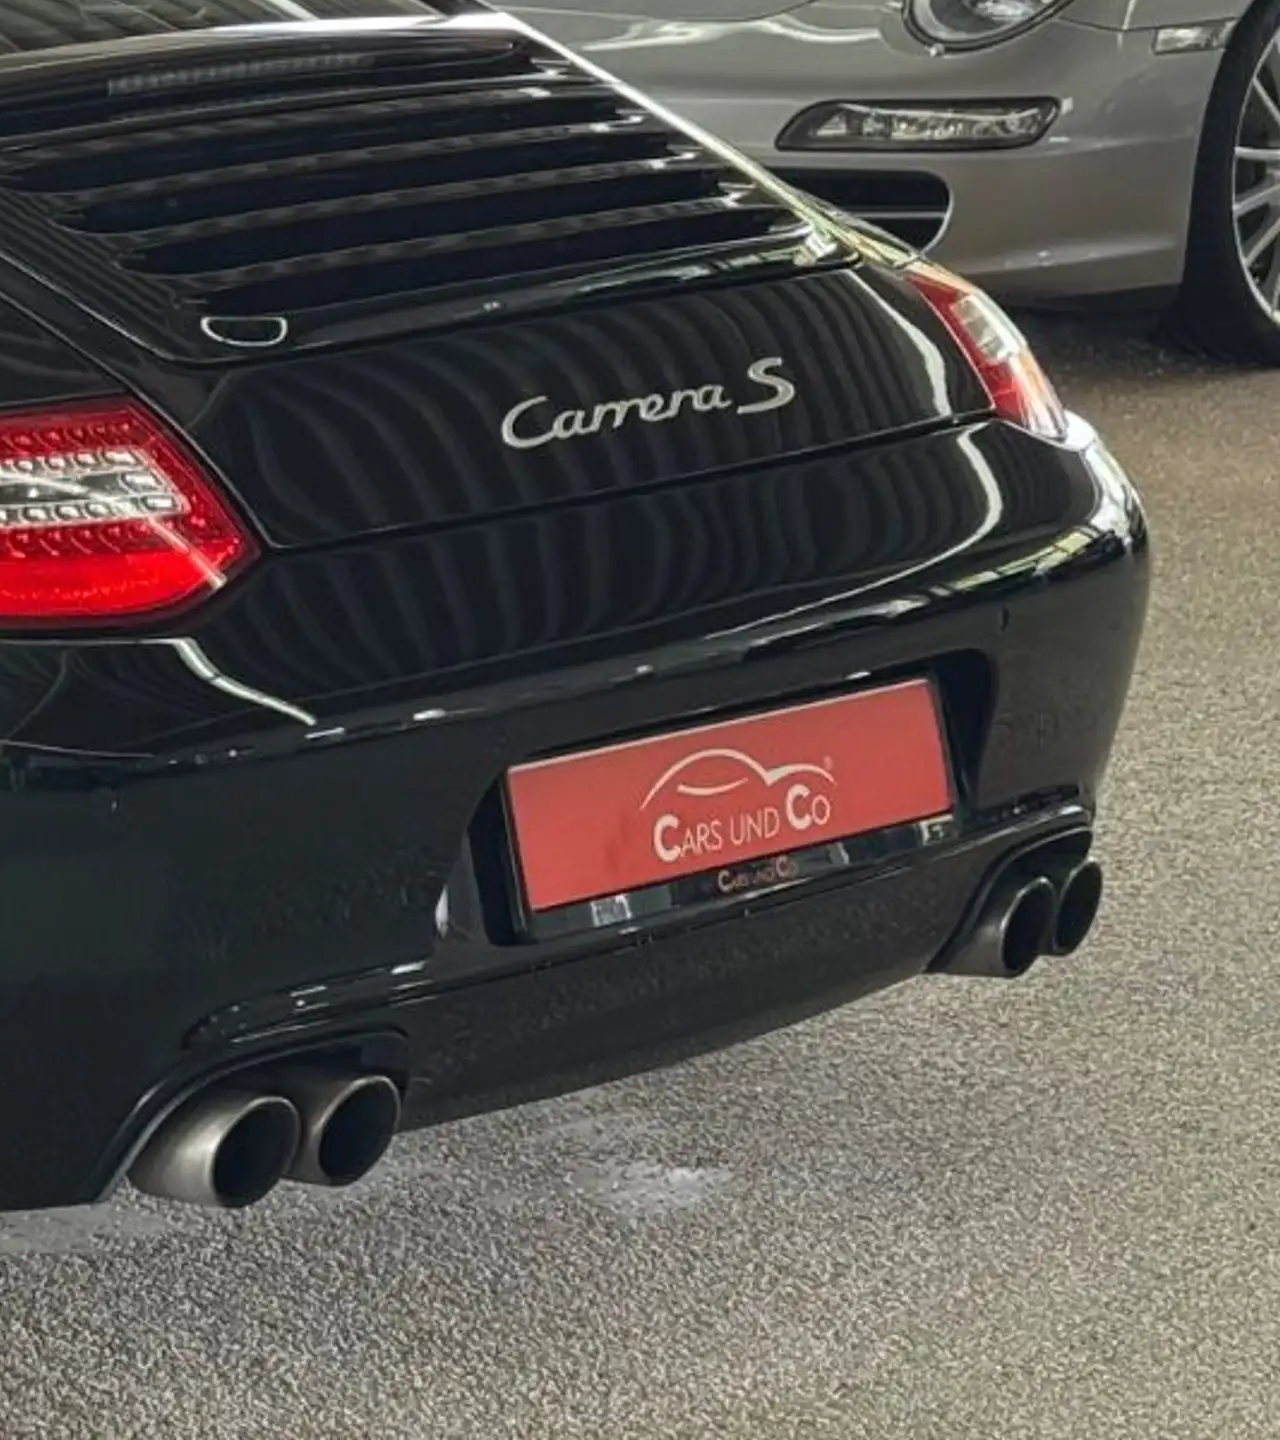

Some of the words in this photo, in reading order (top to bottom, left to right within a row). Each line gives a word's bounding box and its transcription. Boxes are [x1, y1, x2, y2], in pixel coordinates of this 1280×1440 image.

[502, 384, 732, 448] Carrera
[738, 357, 795, 413] S
[730, 807, 780, 845] UND
